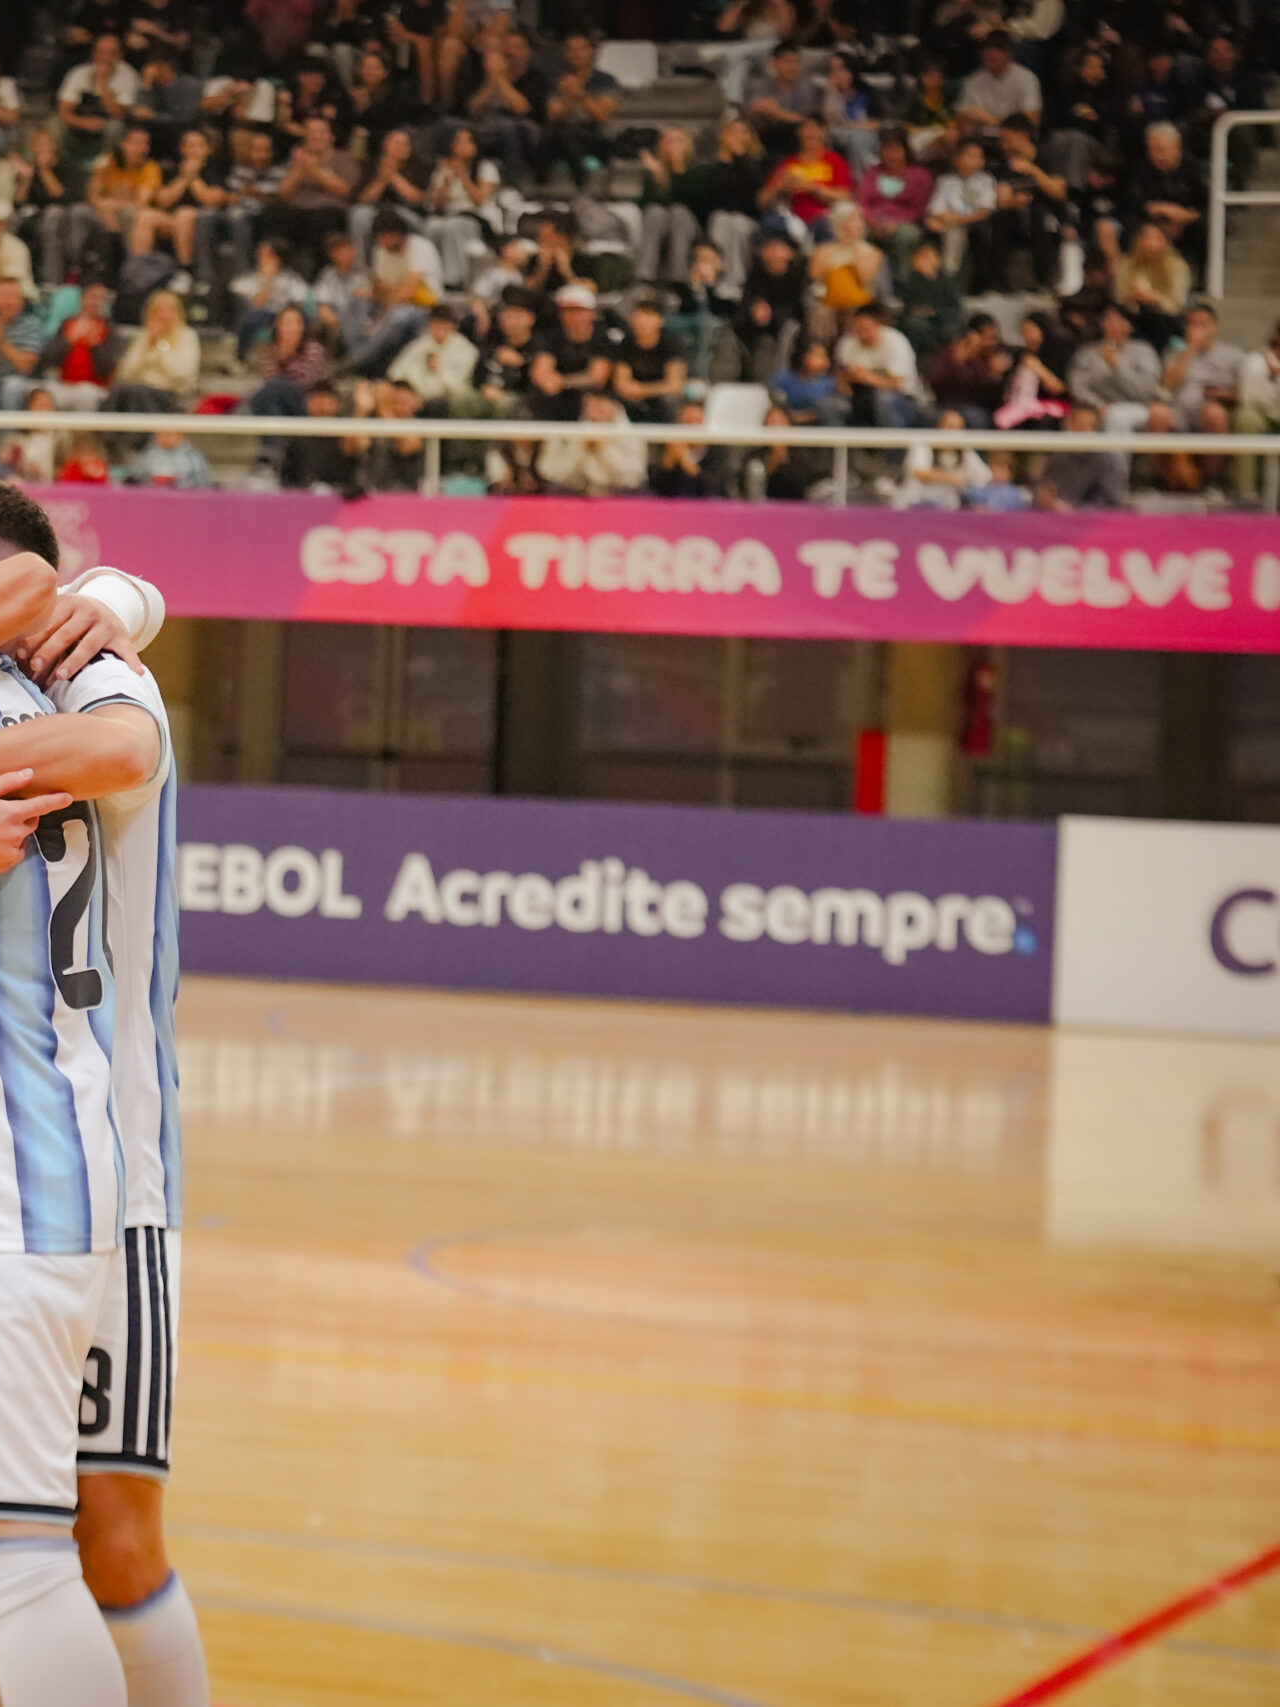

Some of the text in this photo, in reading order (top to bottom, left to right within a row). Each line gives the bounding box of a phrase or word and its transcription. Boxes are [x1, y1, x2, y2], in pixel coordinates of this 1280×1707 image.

[299, 524, 490, 588] ESTA
[505, 531, 783, 597] TIERRA
[797, 538, 901, 601] TE
[916, 542, 1234, 612] VUELVE
[385, 853, 709, 938] Acredite
